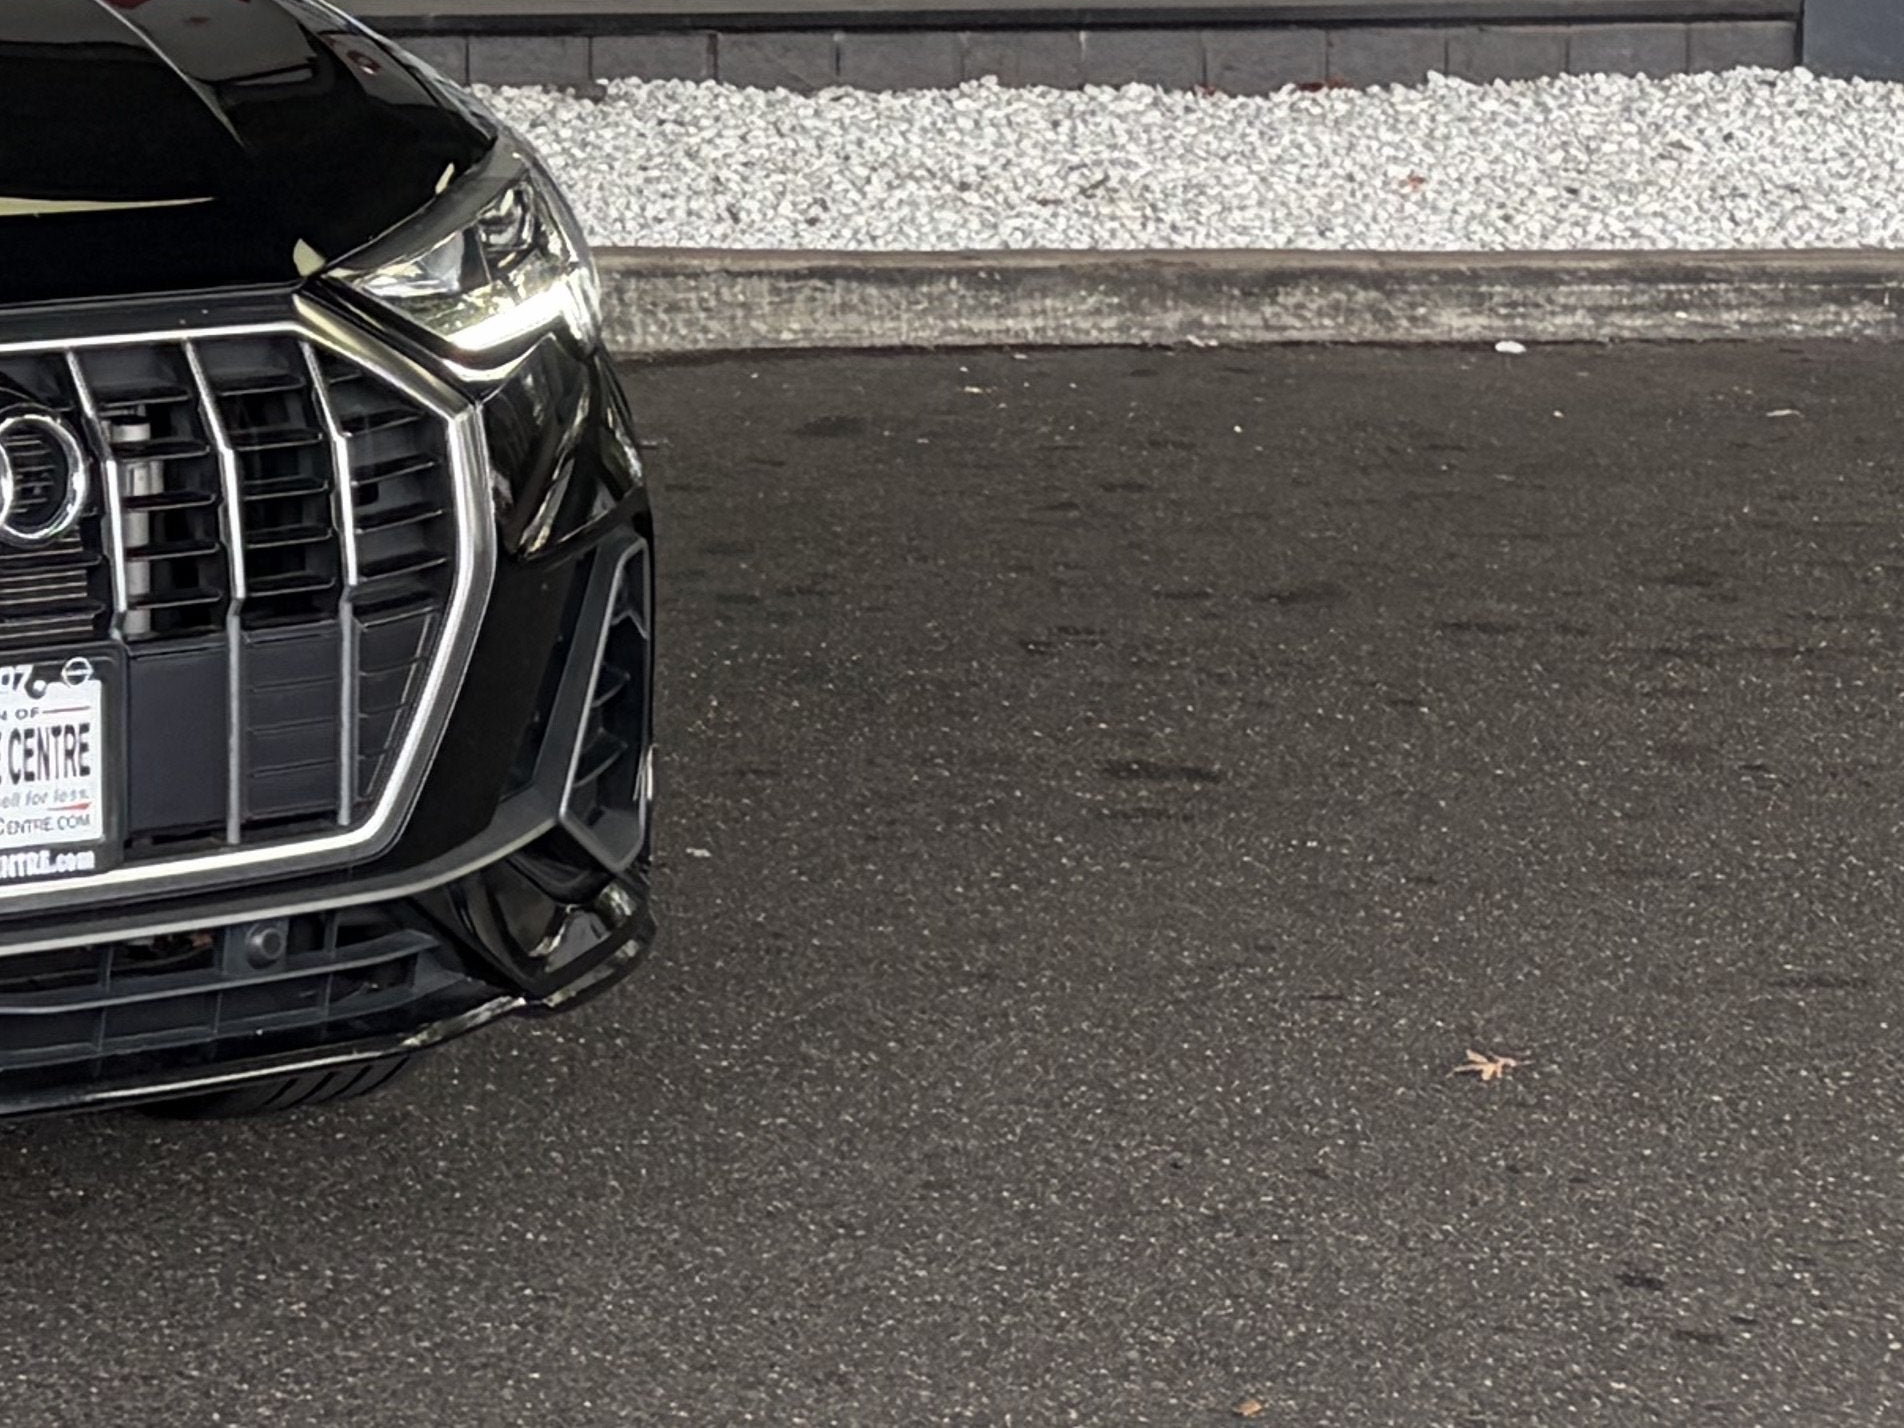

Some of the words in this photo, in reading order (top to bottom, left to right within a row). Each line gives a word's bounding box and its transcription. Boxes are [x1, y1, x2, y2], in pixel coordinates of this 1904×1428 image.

[15, 706, 41, 721] OF
[7, 721, 91, 786] CENTRE
[25, 789, 49, 807] for
